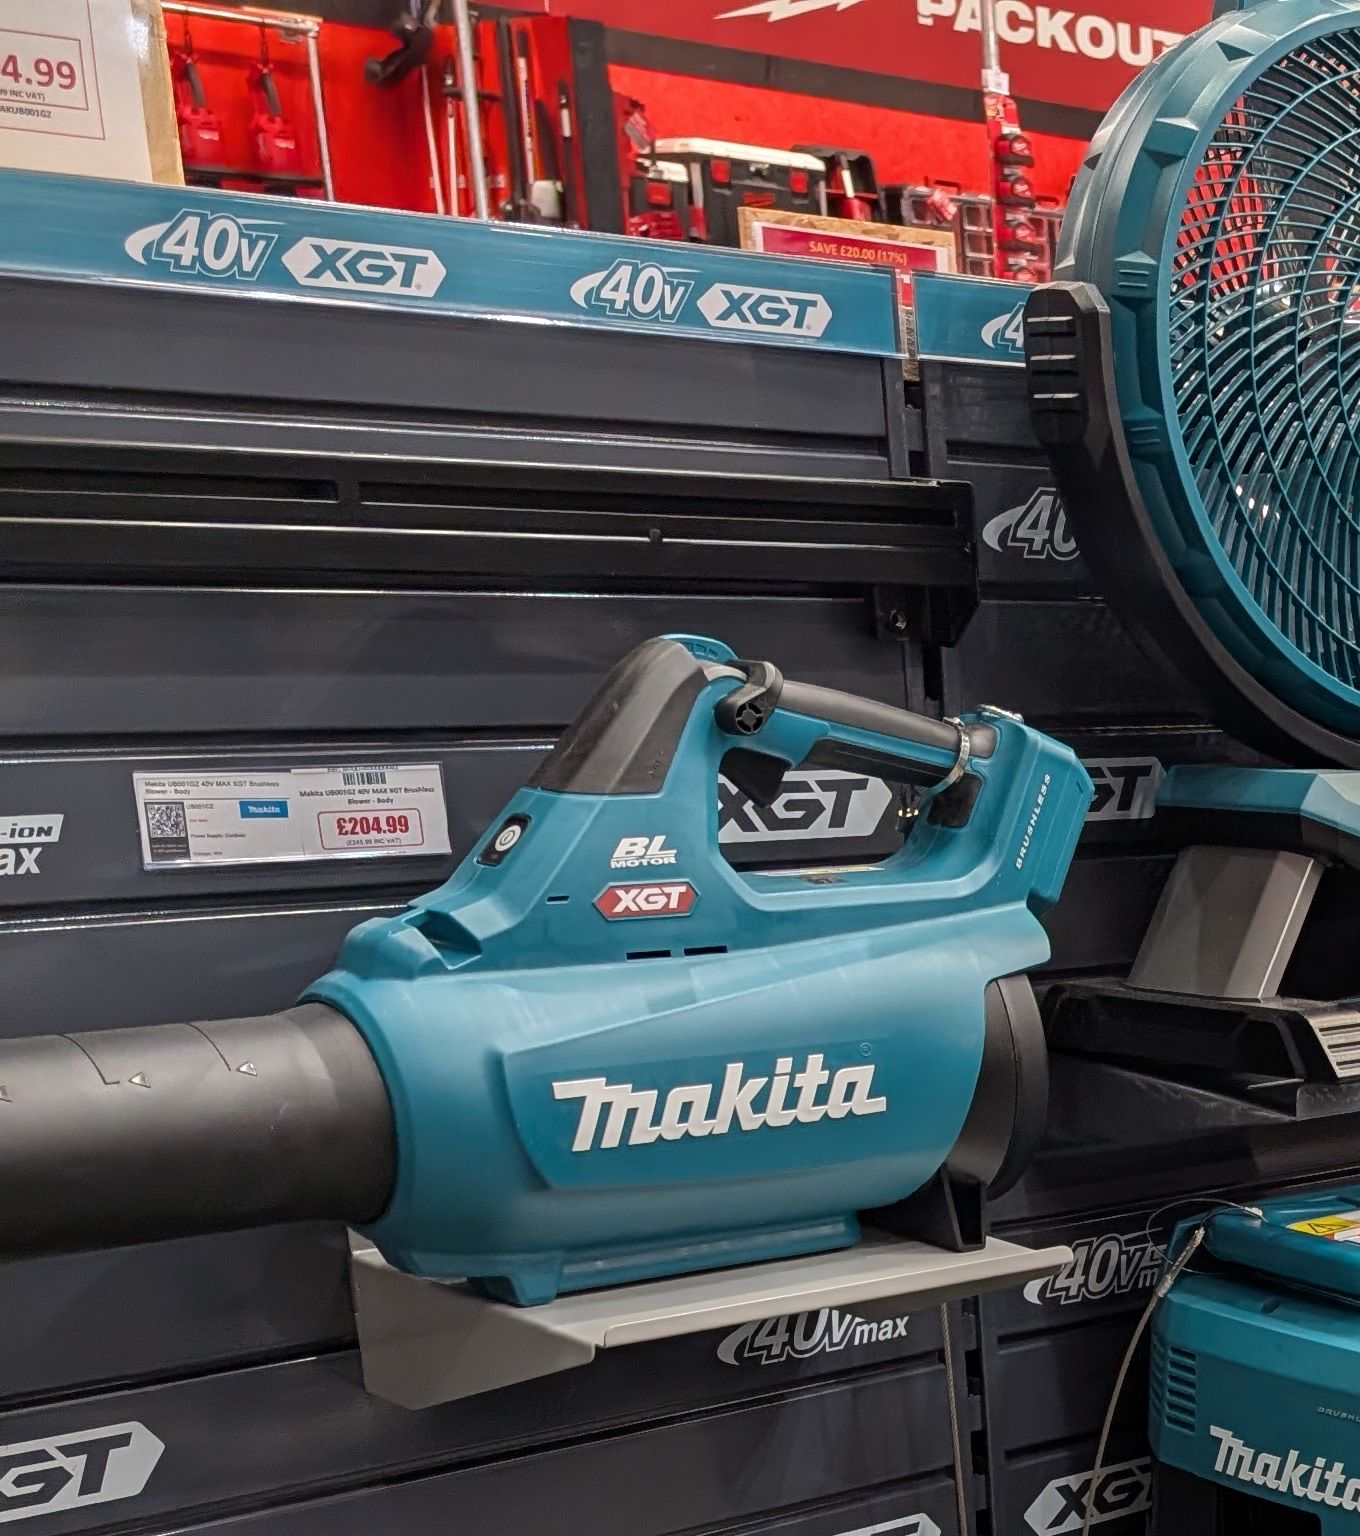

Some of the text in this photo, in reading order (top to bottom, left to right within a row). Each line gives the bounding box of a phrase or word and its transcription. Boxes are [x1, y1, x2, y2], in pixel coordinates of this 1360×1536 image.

[0, 55, 76, 90] 4.99
[304, 244, 430, 289] XGT
[809, 240, 838, 258] SAVE
[840, 242, 876, 262] £20.00
[720, 290, 818, 332] XGT
[336, 815, 410, 836] £204.99
[1015, 773, 1053, 872] BRUSHLESS
[0, 843, 41, 876] ax
[610, 855, 678, 870] MOTOR
[611, 836, 678, 860] BL
[611, 885, 688, 914] XGT
[552, 1053, 887, 1152] Makita
[854, 1313, 910, 1346] max
[0, 1431, 134, 1499] GT
[1047, 1461, 1152, 1529] XG
